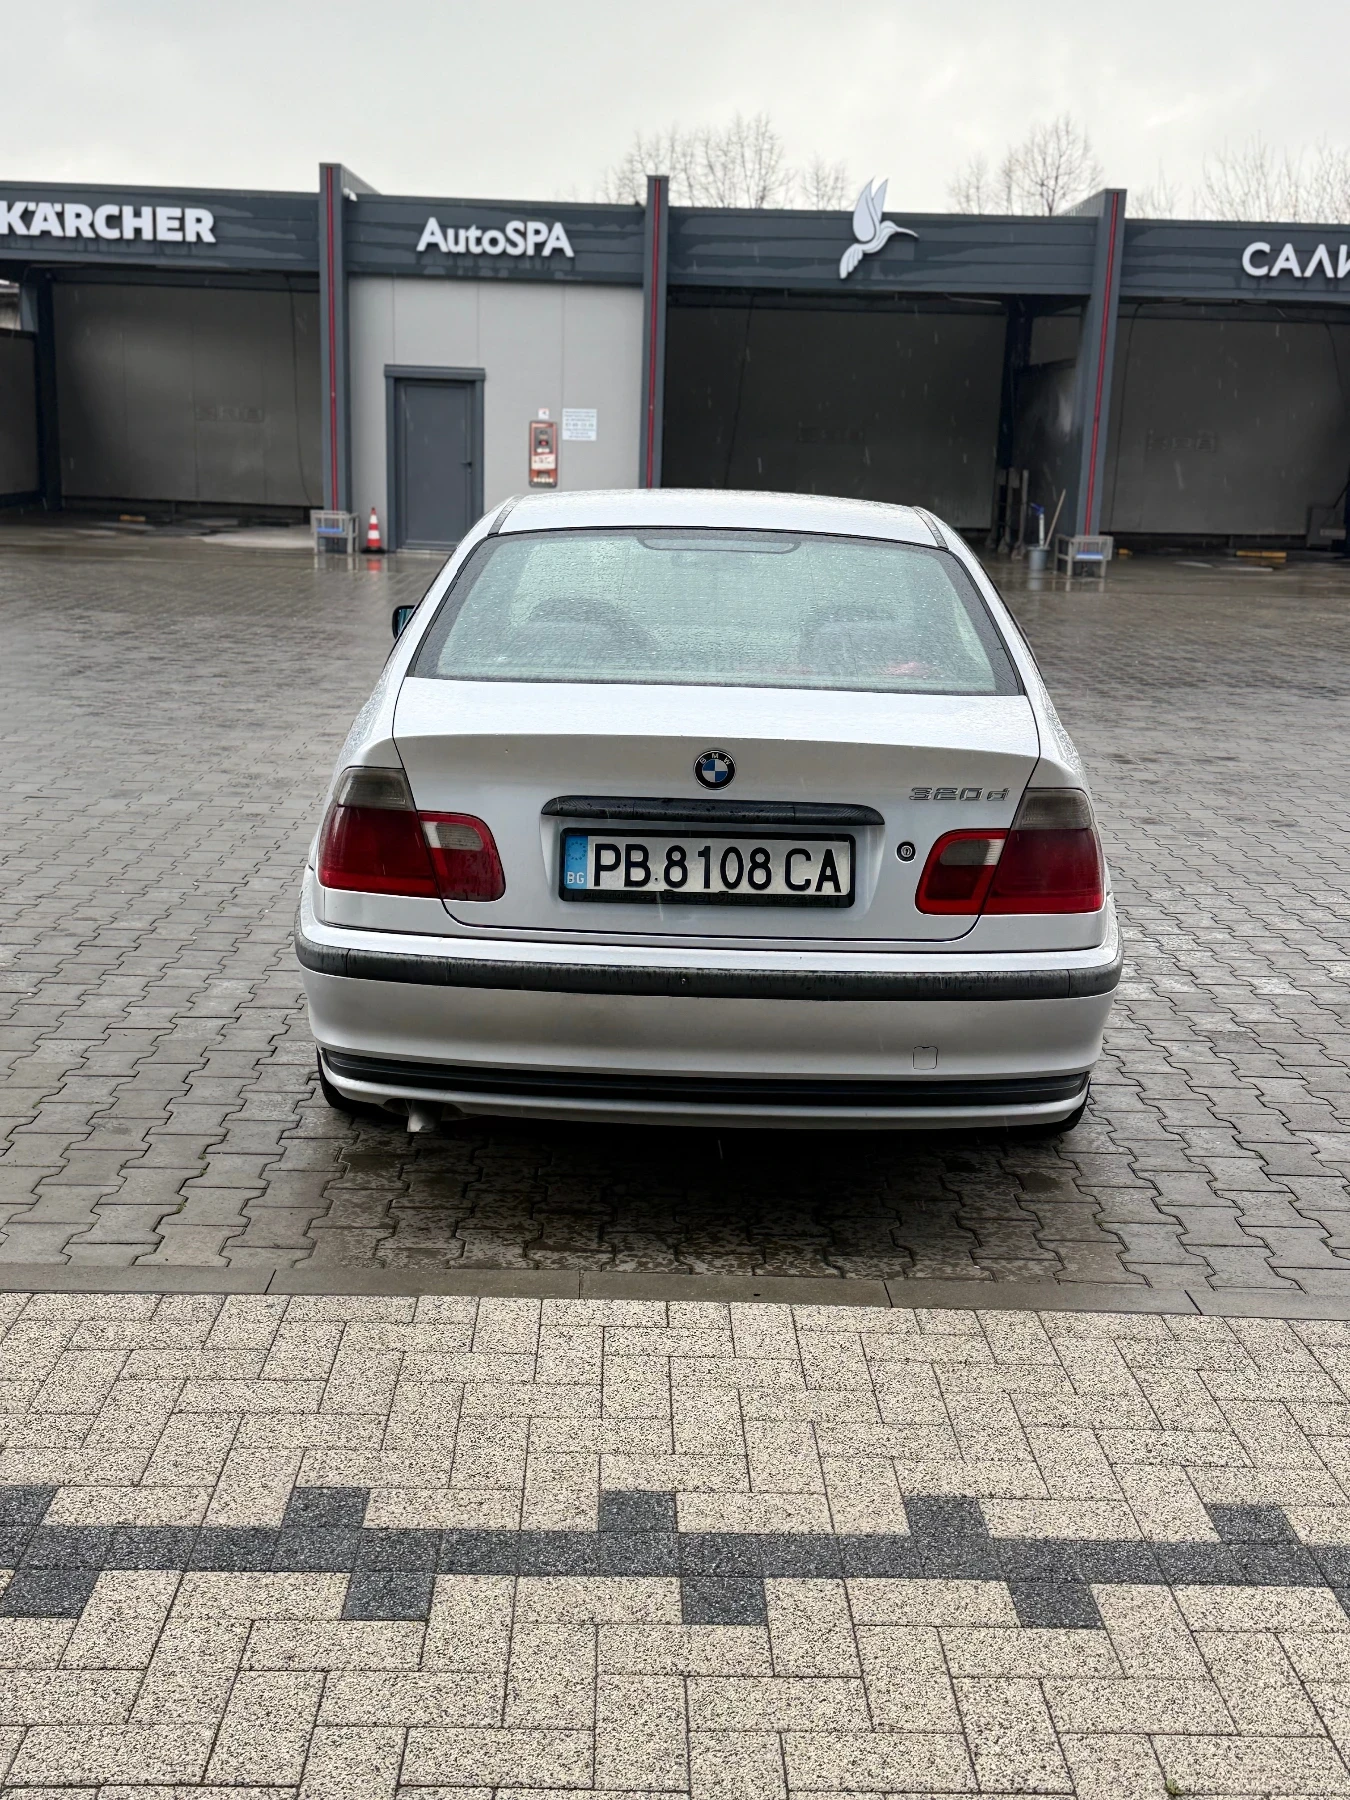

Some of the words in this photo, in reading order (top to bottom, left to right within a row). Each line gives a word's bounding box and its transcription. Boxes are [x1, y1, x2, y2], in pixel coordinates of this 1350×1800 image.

[0, 201, 217, 243] KÄRCHER
[416, 216, 575, 258] AutoSPA
[700, 752, 731, 765] BMW
[909, 787, 1010, 801] 320d
[566, 871, 585, 884] BG
[663, 844, 772, 891] 8108
